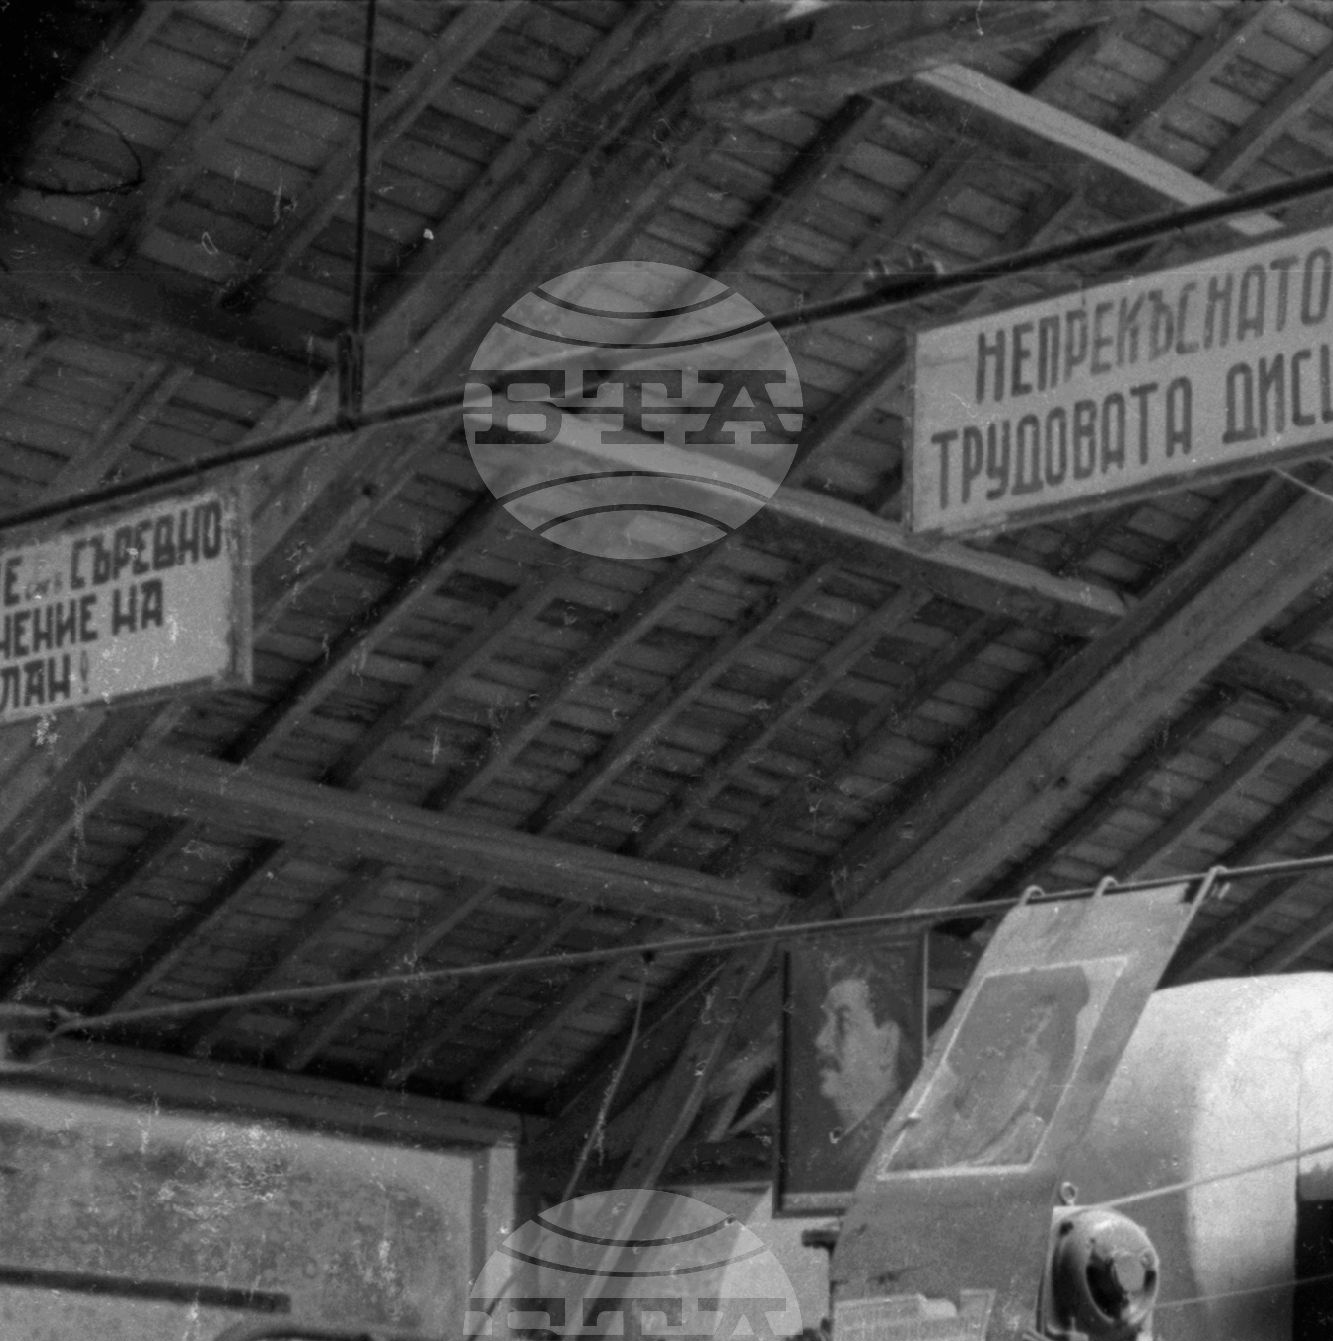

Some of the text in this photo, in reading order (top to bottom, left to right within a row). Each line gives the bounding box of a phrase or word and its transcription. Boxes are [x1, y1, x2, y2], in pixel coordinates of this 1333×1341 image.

[977, 247, 1333, 404] НЕПРЕКЪСНАТО
[930, 376, 1193, 510] ТРУДОВАТА
[71, 500, 223, 590] СЪРЕВНО
[112, 577, 164, 636] НА
